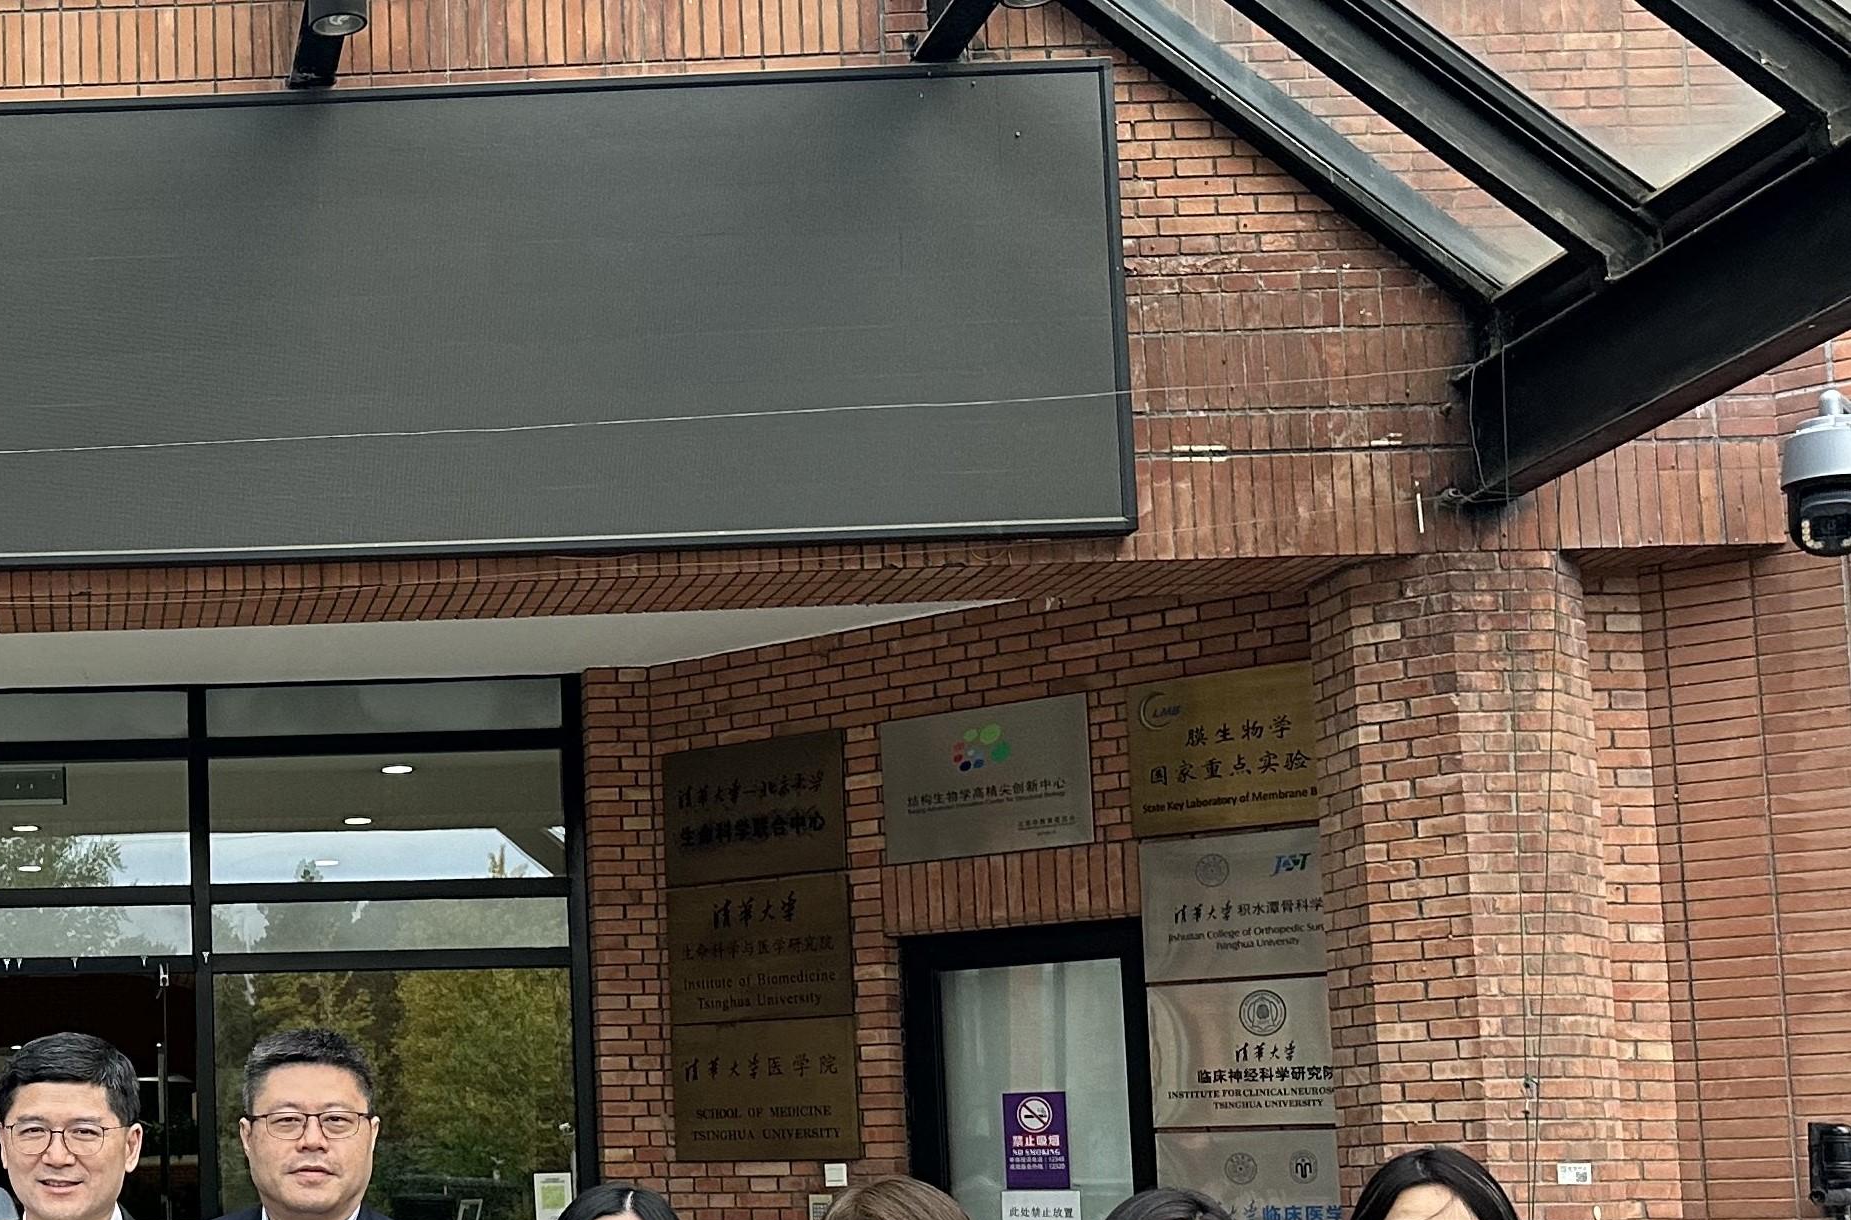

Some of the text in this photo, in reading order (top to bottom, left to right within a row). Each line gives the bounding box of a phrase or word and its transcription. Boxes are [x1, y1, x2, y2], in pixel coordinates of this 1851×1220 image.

[1185, 713, 1292, 747] 膜生物学
[1150, 749, 1313, 786] 国家重点实验
[907, 776, 1066, 807] 结构生物学高精尖创新中心
[1142, 803, 1166, 814] State
[1167, 802, 1184, 812] Key
[1186, 795, 1238, 809] Laboratory
[1238, 792, 1249, 803] of
[1251, 788, 1308, 802] Membrane
[1206, 928, 1240, 940] College
[1242, 927, 1252, 937] of
[1254, 923, 1305, 936] Orthopedic
[684, 933, 835, 961] 生命科学与医学研究院
[1216, 937, 1299, 951] Tsinghua University
[684, 969, 836, 991] Institute of Biomedicine
[698, 992, 822, 1012] Tsinghua University
[1168, 1089, 1219, 1100] INSTITUTE
[1222, 1088, 1242, 1098] FOR
[1243, 1087, 1290, 1097] CLINICAL
[696, 1104, 832, 1120] SCHOOL OF MEDICINE
[1213, 1099, 1324, 1110] TSINGHUA UNIVERSITY
[692, 1127, 841, 1141] TSINGHUA UNIVERSITY
[1012, 1134, 1060, 1147] 禁止吸烟
[1009, 1207, 1074, 1218] 此处禁止放置
